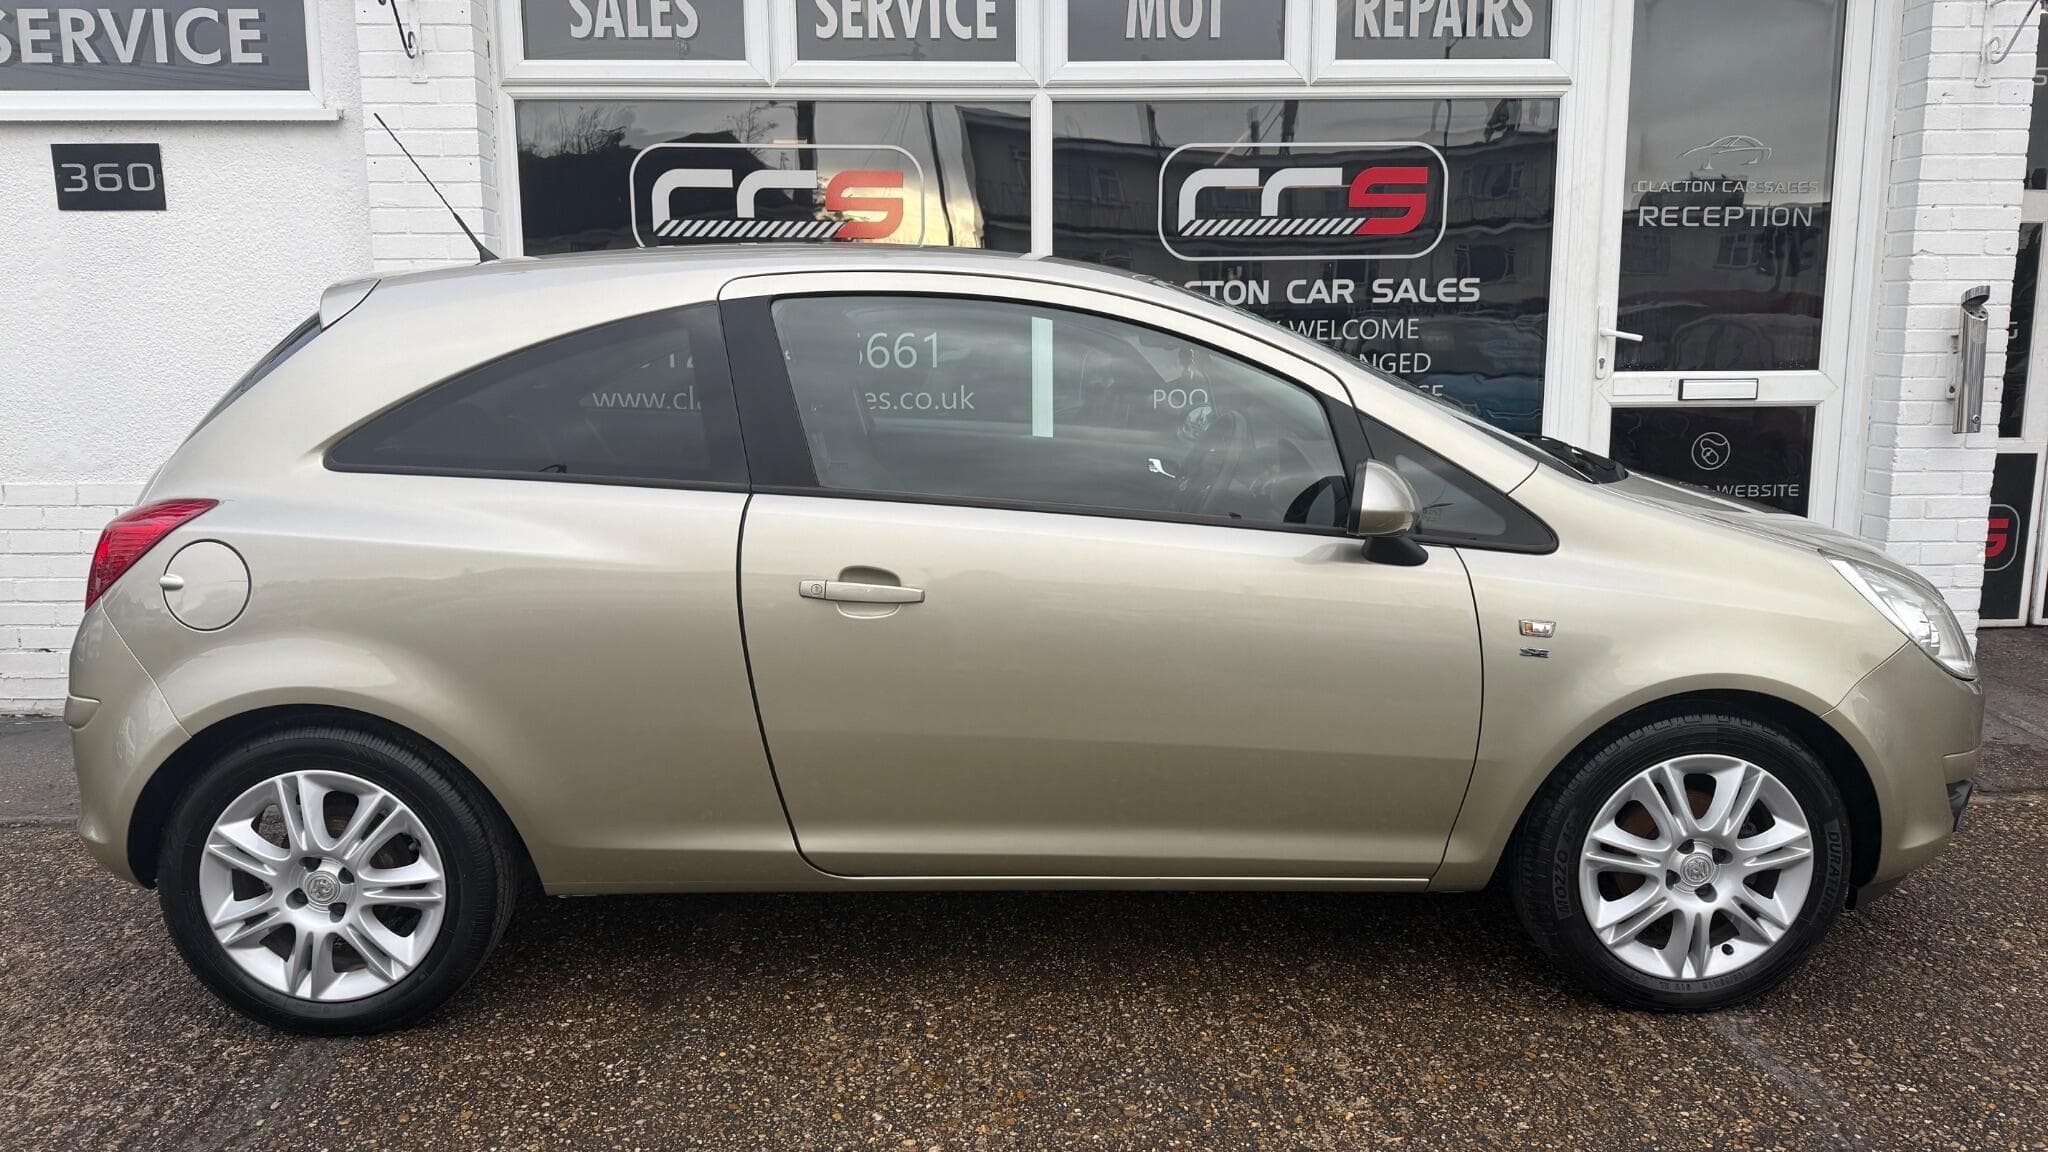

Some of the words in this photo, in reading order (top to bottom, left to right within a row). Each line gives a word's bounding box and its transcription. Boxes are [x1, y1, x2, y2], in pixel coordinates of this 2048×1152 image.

[569, 0, 699, 39] SALES
[815, 0, 997, 40] SERVICE
[1355, 0, 1534, 38] REPAIRS
[61, 162, 156, 193] 360
[1637, 180, 1715, 194] CLACTON
[1722, 180, 1757, 194] CAR
[1763, 180, 1820, 194] SALES
[1638, 206, 1813, 228] RECEPTION
[1286, 278, 1355, 305] CAR
[1372, 278, 1481, 304] SALES
[1288, 317, 1420, 341] WELCOME
[1716, 483, 1800, 498] WEBSITE
